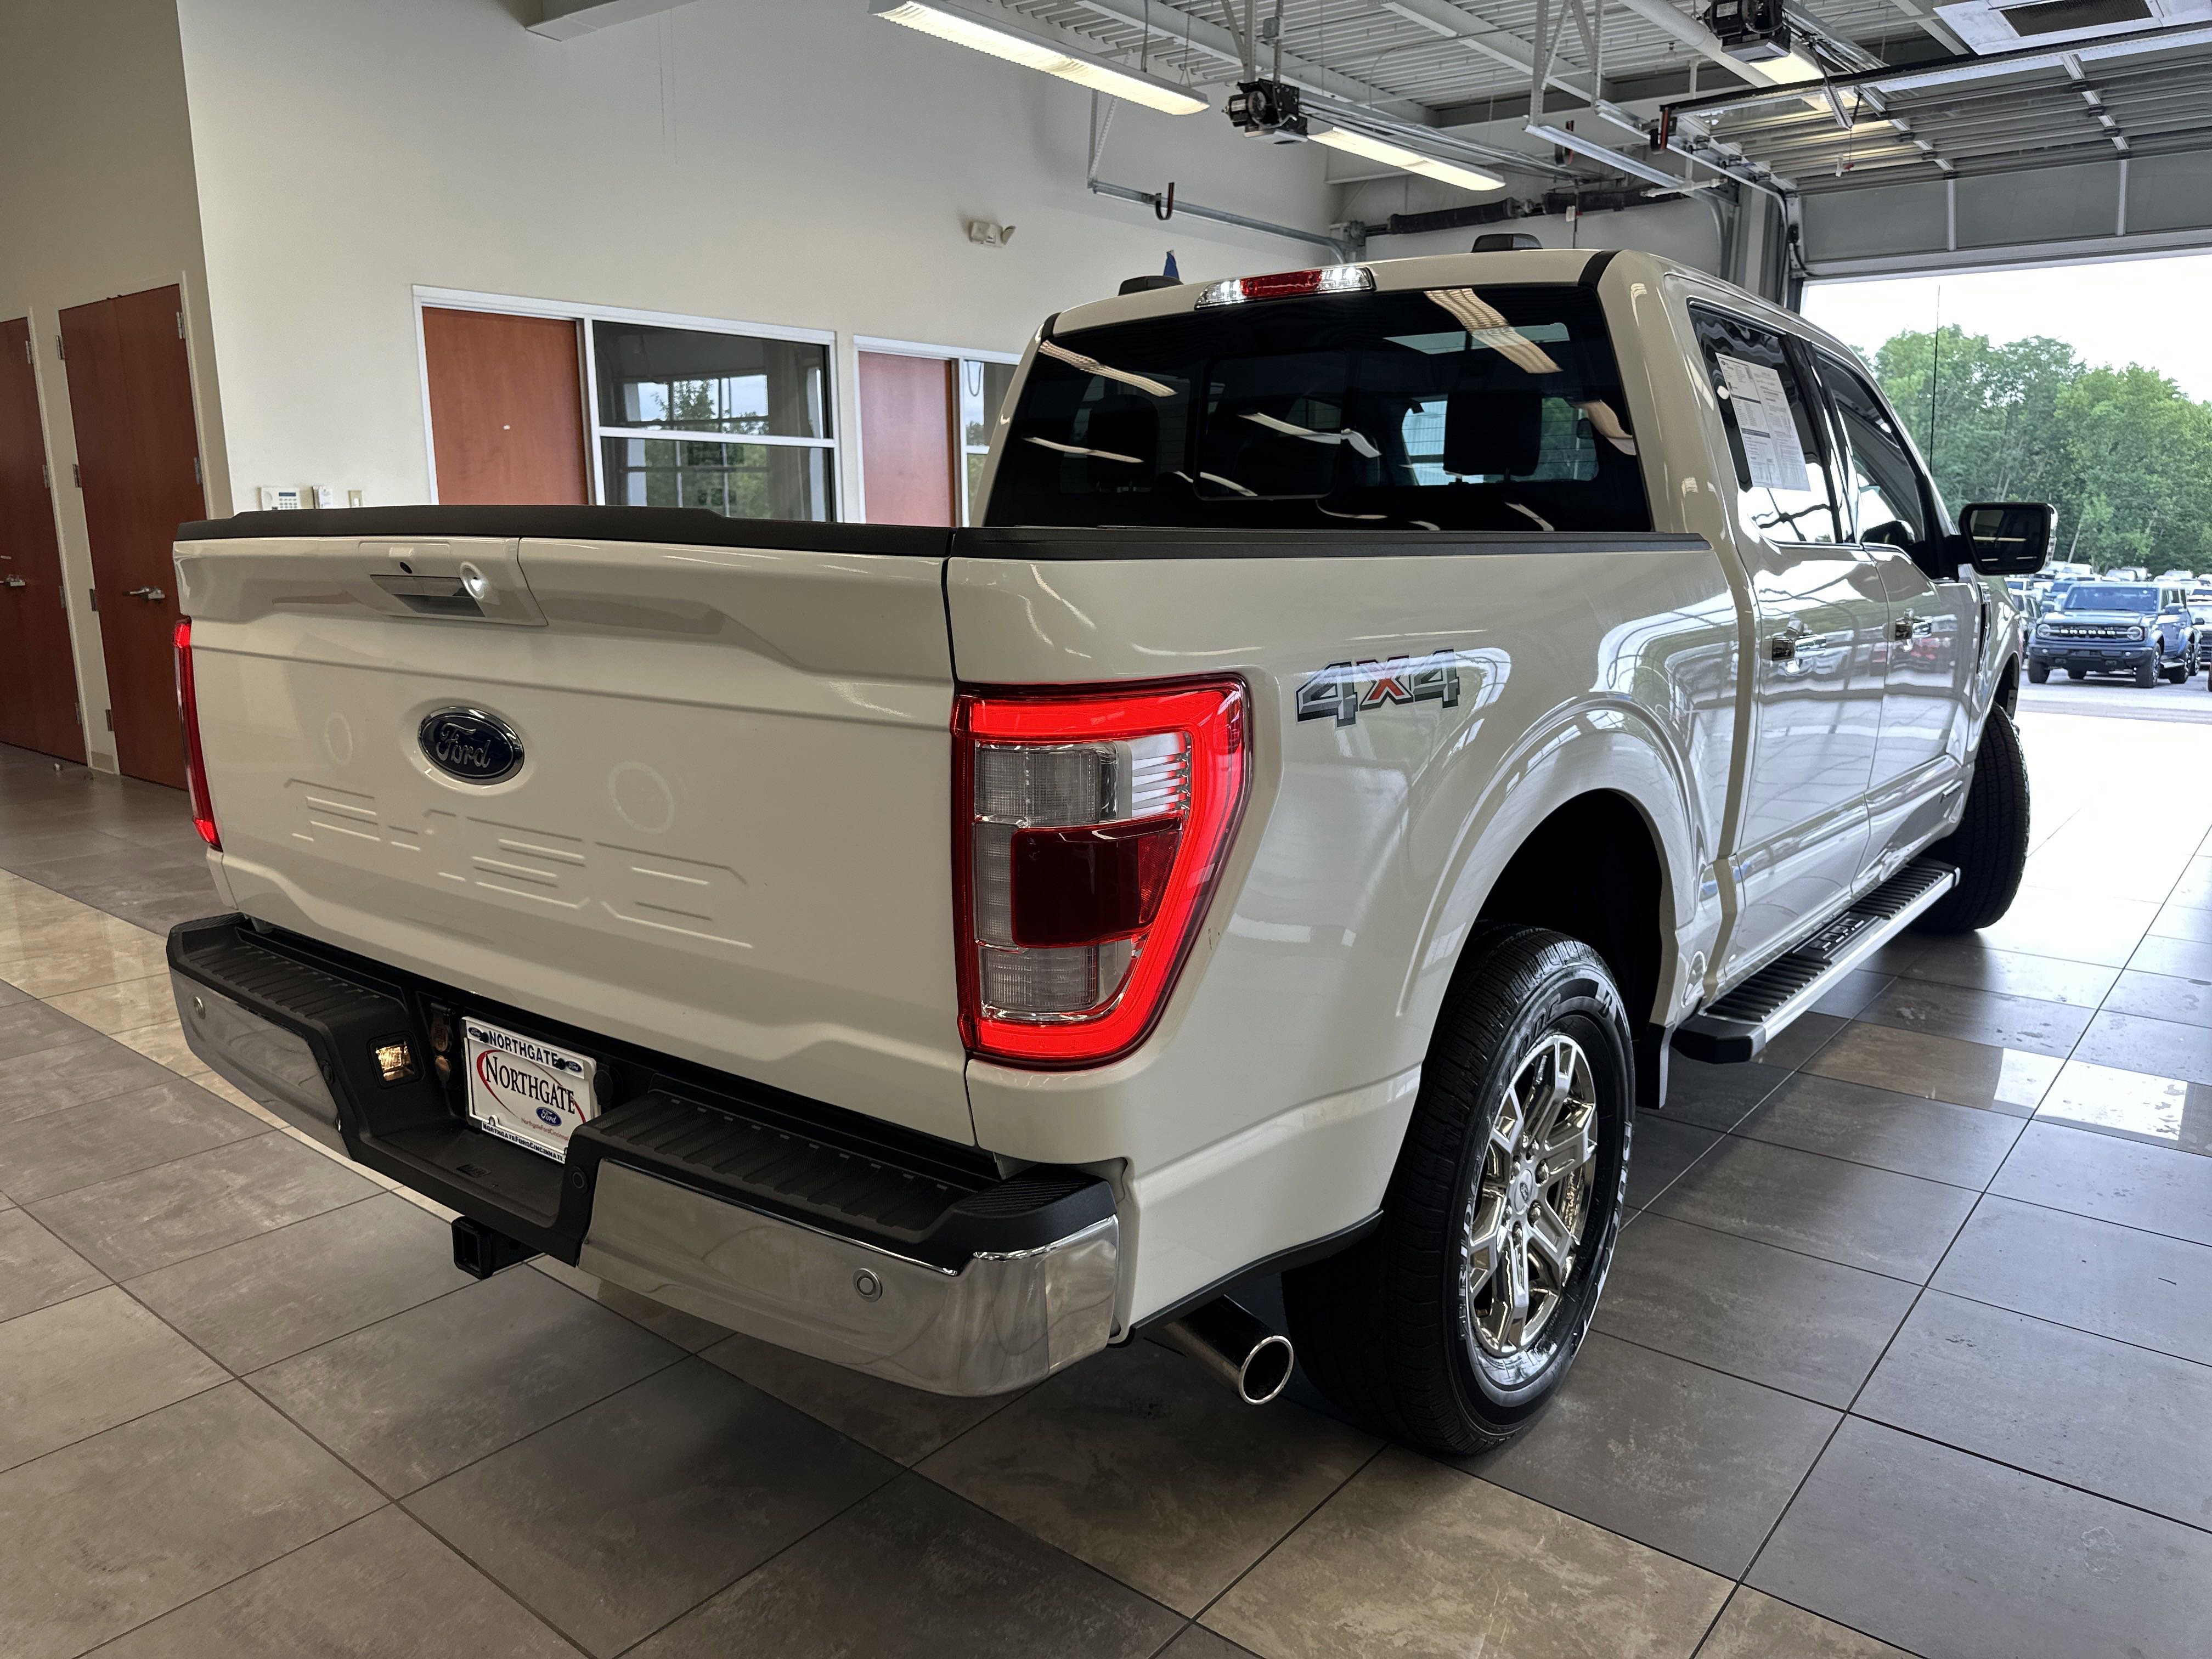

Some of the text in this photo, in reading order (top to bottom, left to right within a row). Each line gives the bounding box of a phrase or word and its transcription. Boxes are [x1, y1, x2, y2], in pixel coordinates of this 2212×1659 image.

[436, 722, 492, 769] Ford
[489, 1030, 558, 1068] NORTHGATE
[486, 1053, 575, 1115] NORTHGATE
[540, 1109, 557, 1124] Ford
